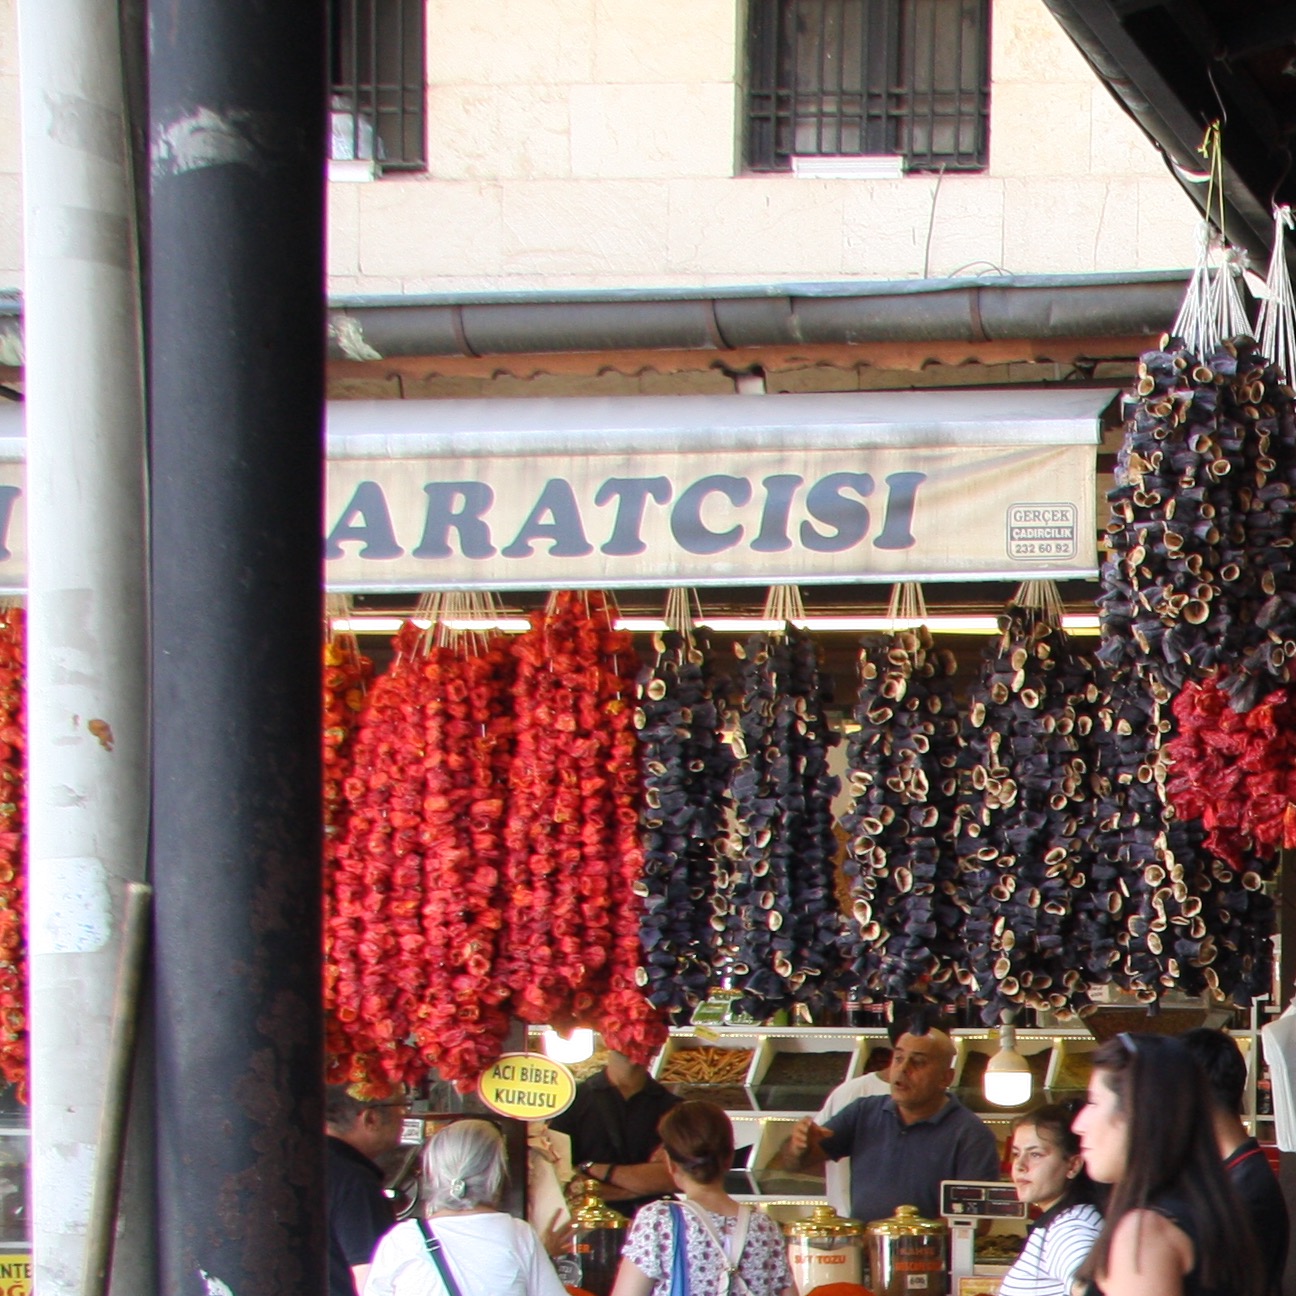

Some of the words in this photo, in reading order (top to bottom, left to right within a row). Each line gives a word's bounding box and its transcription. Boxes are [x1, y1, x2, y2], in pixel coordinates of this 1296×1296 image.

[1013, 509, 1070, 525] GERÇEK
[1015, 543, 1036, 554] 232
[1039, 543, 1052, 554] 60
[492, 1065, 515, 1082] ACI
[520, 1063, 559, 1086] BİBER
[494, 1088, 557, 1109] KURUSU
[816, 1254, 847, 1265] TOZU
